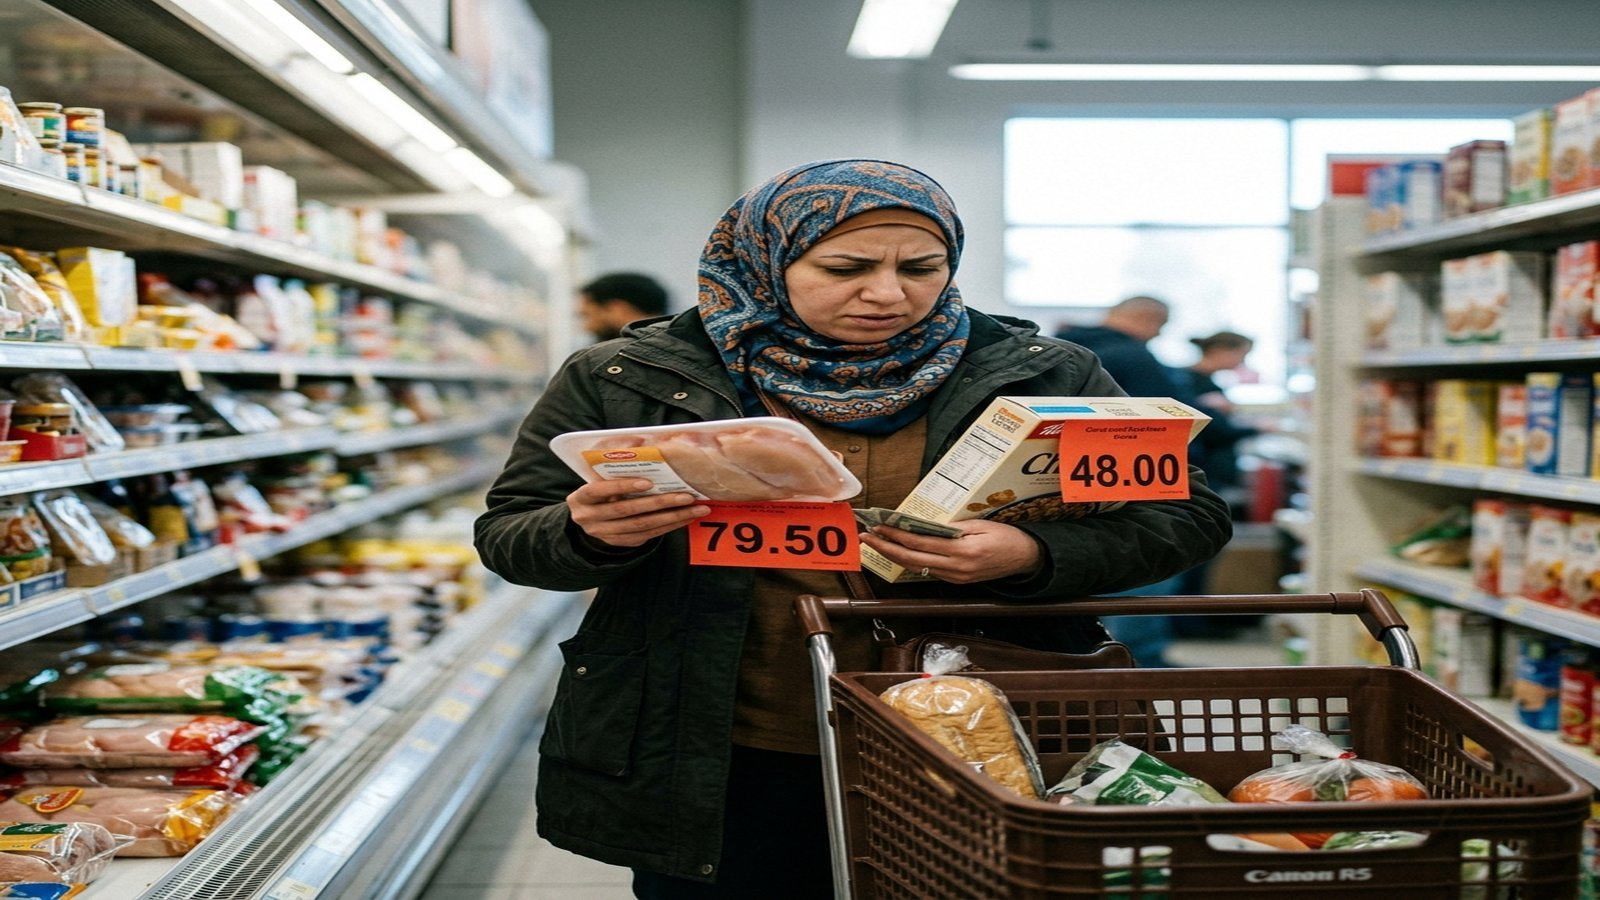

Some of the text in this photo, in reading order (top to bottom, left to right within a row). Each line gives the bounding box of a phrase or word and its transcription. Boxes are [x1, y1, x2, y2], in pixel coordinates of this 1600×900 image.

[1070, 453, 1179, 488] 48.00
[699, 521, 848, 557] 79.50
[1244, 869, 1332, 883] Canon
